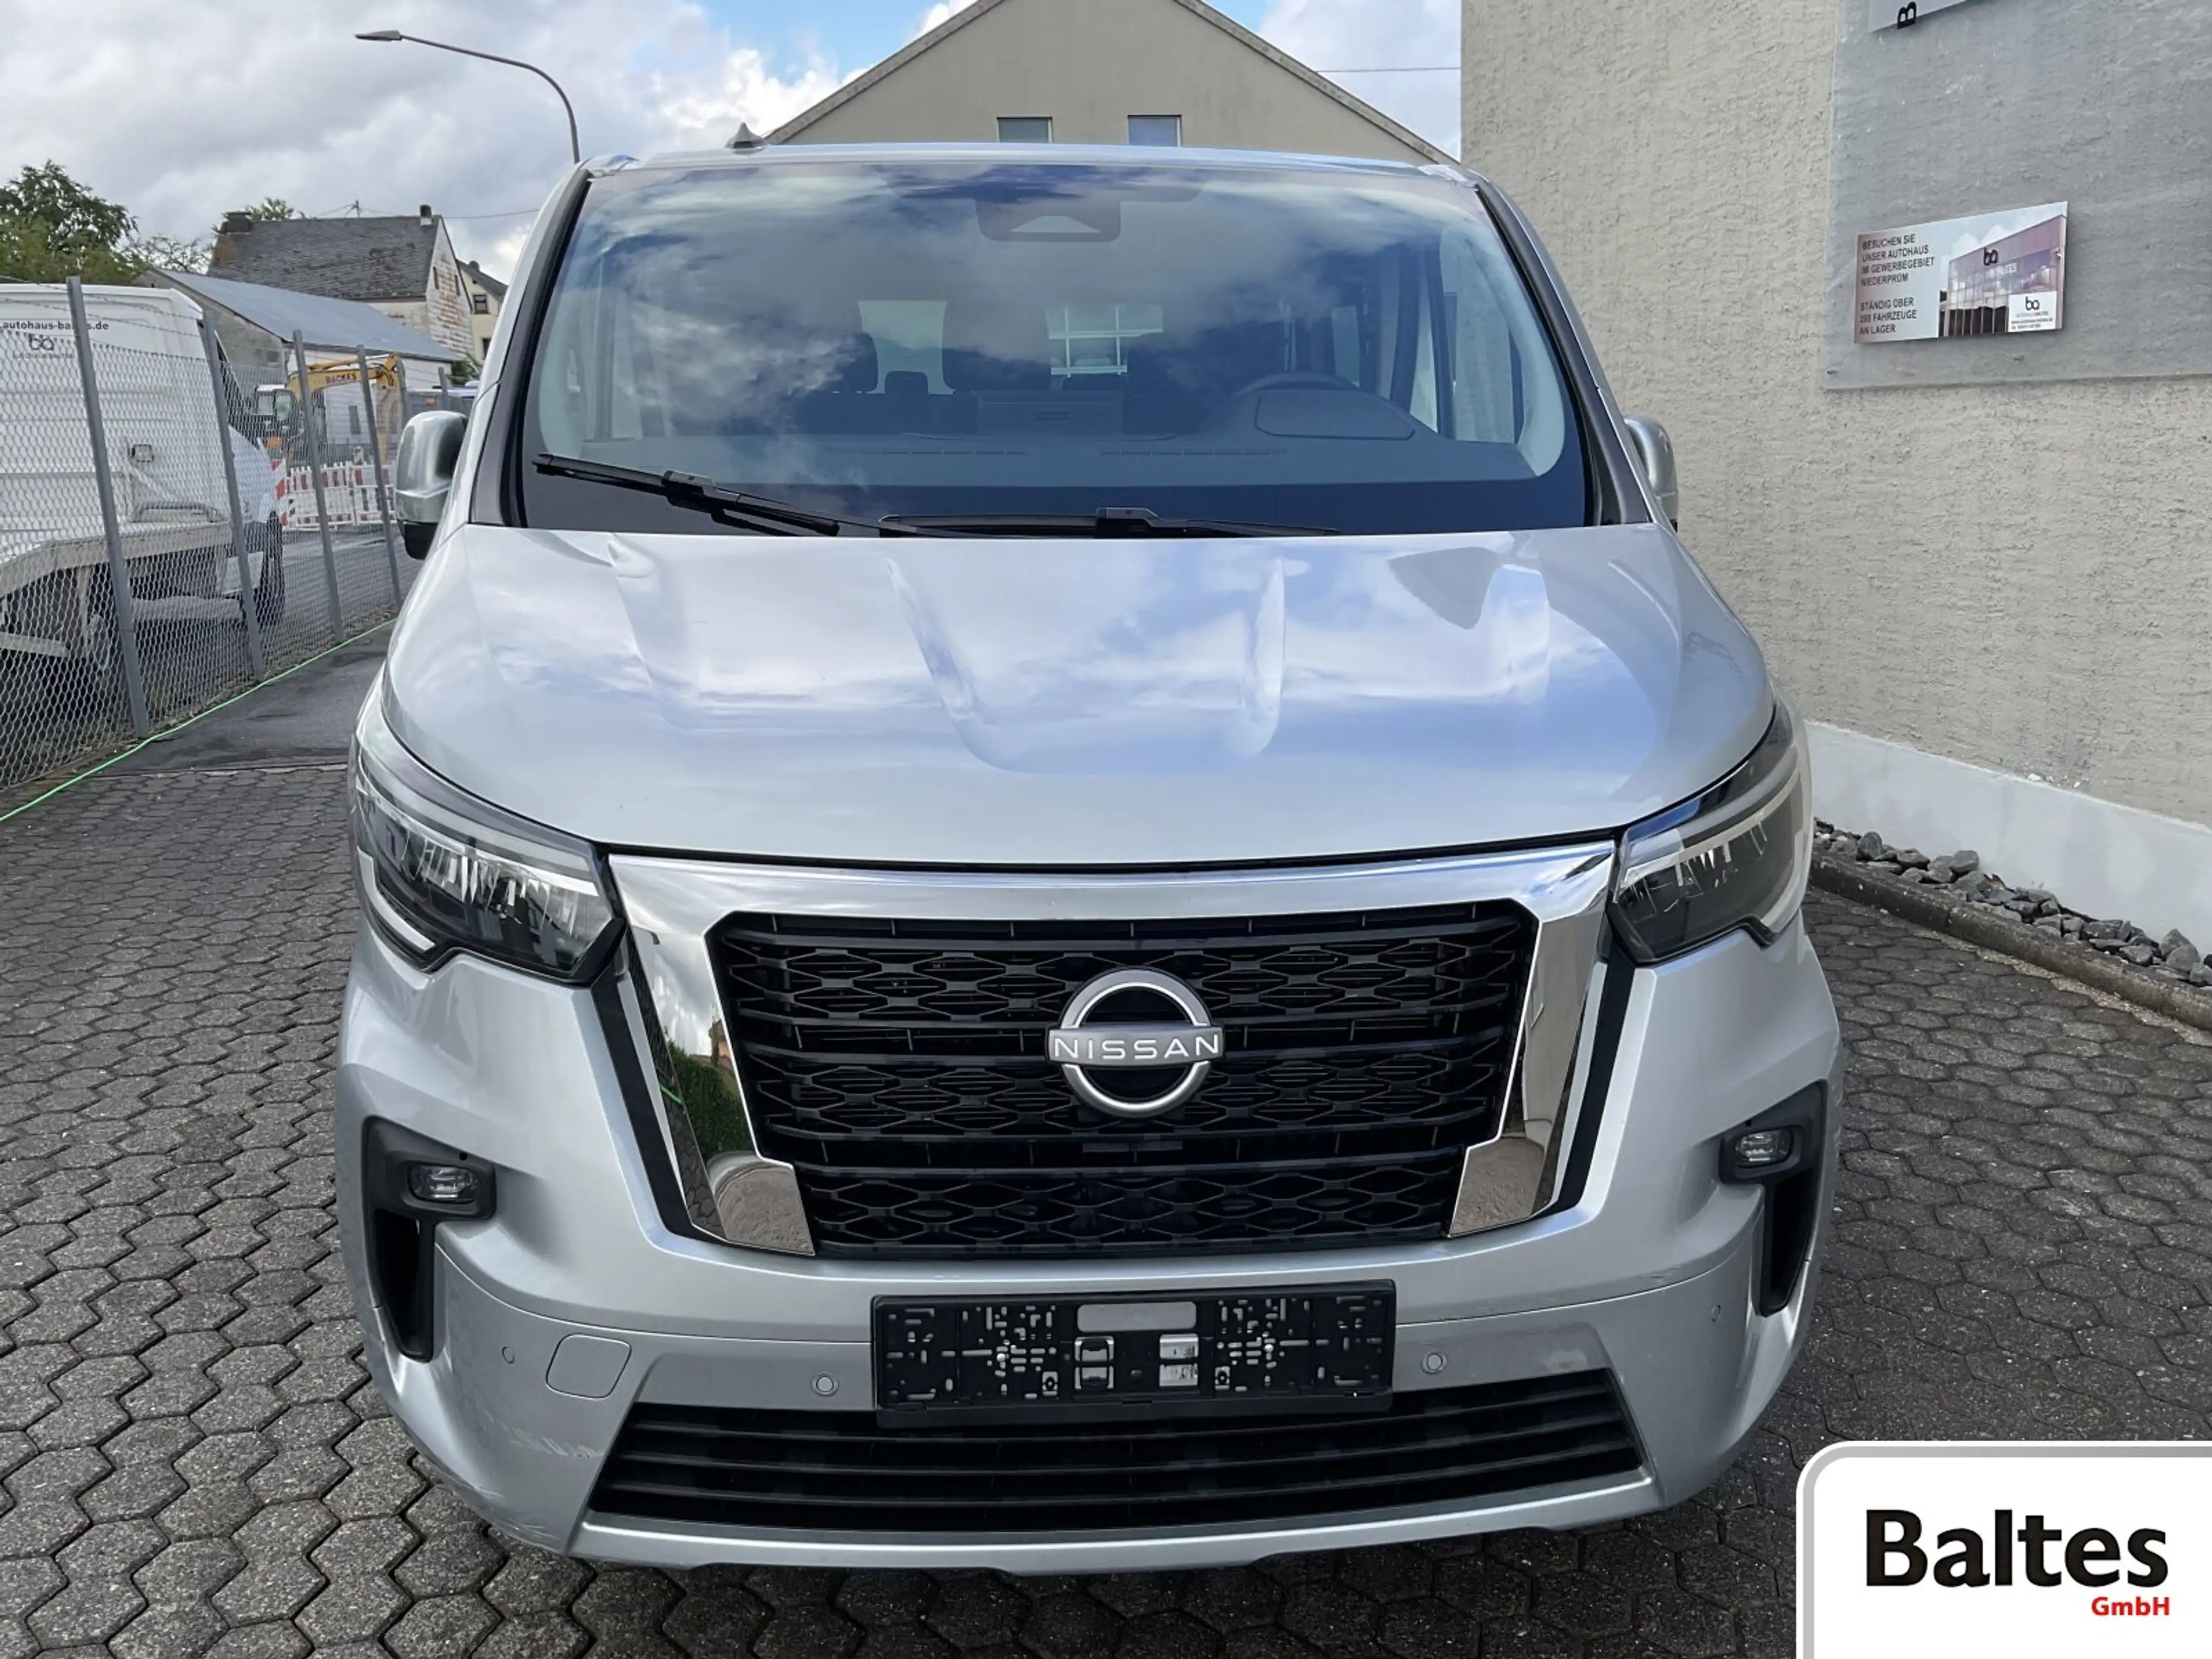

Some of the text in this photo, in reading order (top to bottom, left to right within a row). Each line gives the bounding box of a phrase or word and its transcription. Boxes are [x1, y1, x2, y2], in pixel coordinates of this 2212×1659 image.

[1862, 233, 1916, 250] BESUCHEN SIE
[1862, 244, 1929, 262] UNSER AUTOHAUS
[1870, 256, 1935, 273] GEWERBEGEBIET
[1873, 309, 1917, 323] FAHRZEUGE
[1859, 324, 1896, 335] AN LAGER
[1054, 1033, 1219, 1060] NISSAN
